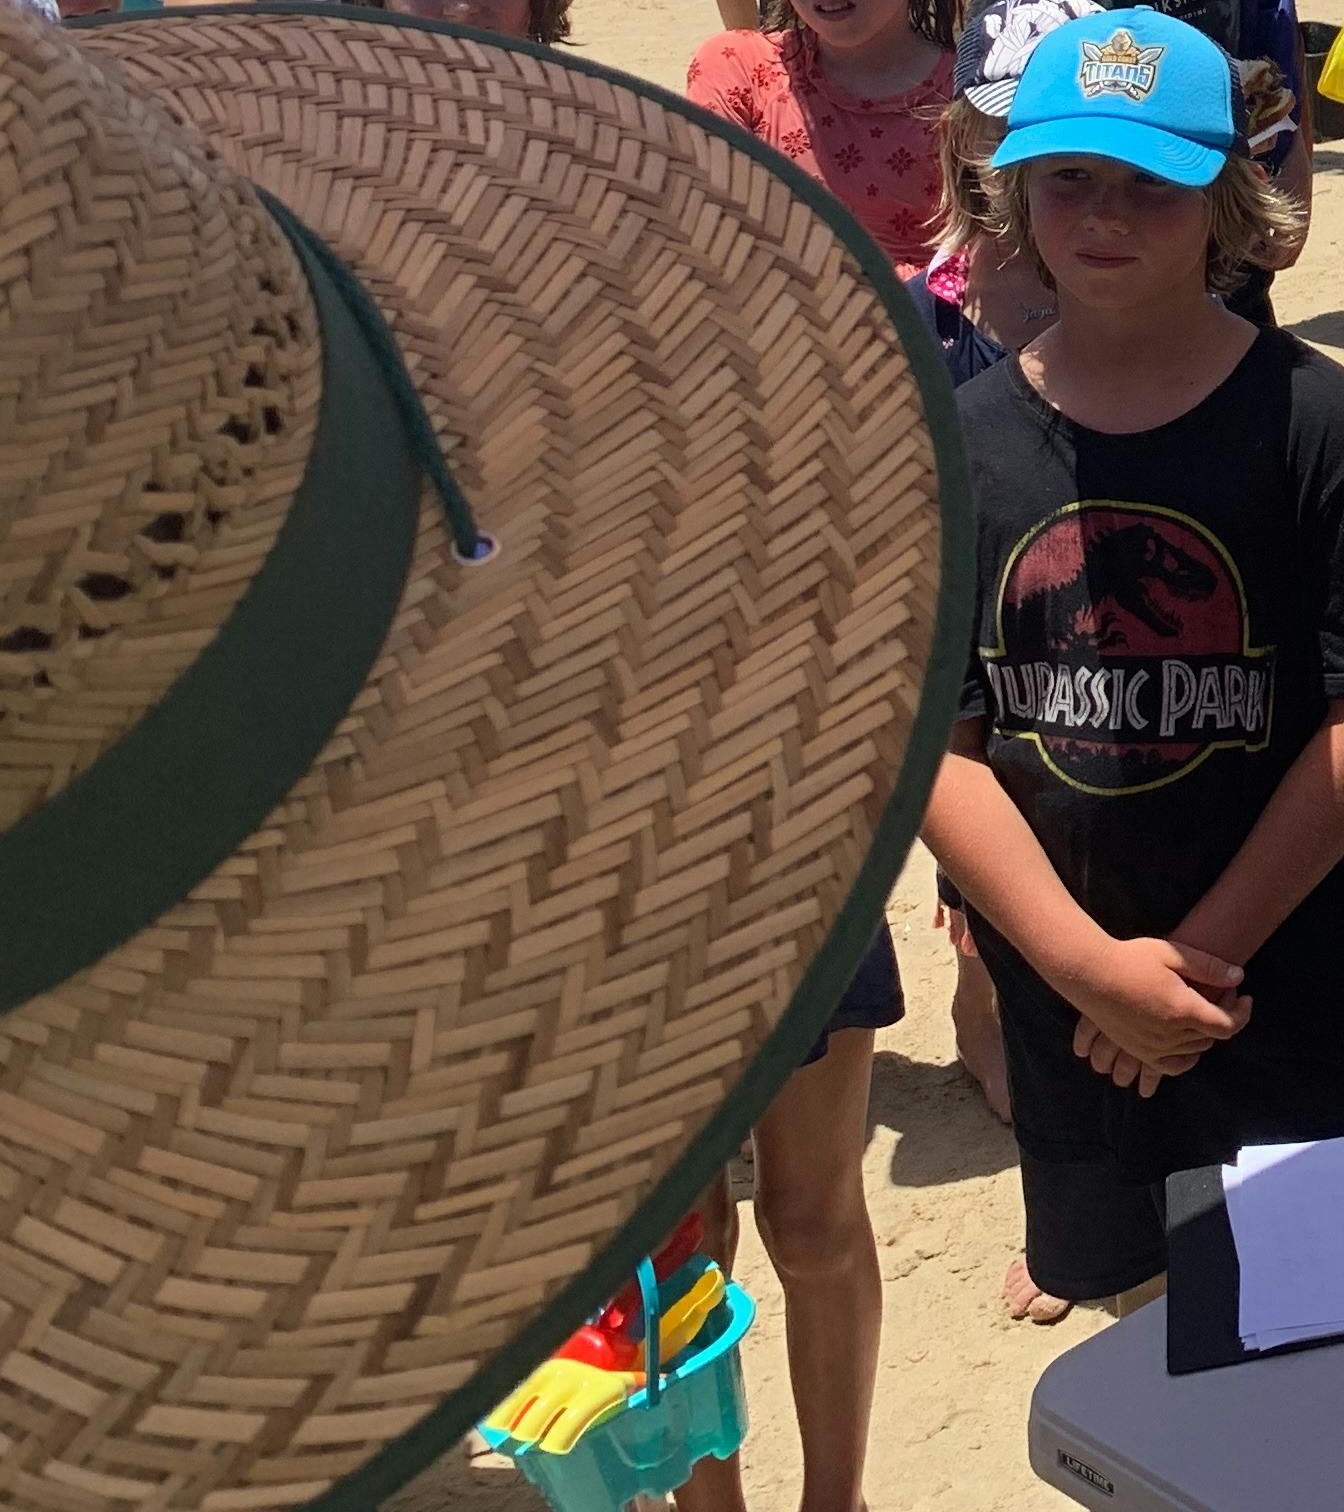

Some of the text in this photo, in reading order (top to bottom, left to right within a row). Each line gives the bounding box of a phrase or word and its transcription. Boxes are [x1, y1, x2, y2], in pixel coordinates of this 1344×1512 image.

[1085, 62, 1152, 86] TITANS
[986, 658, 1267, 737] JURASSIC PARK
